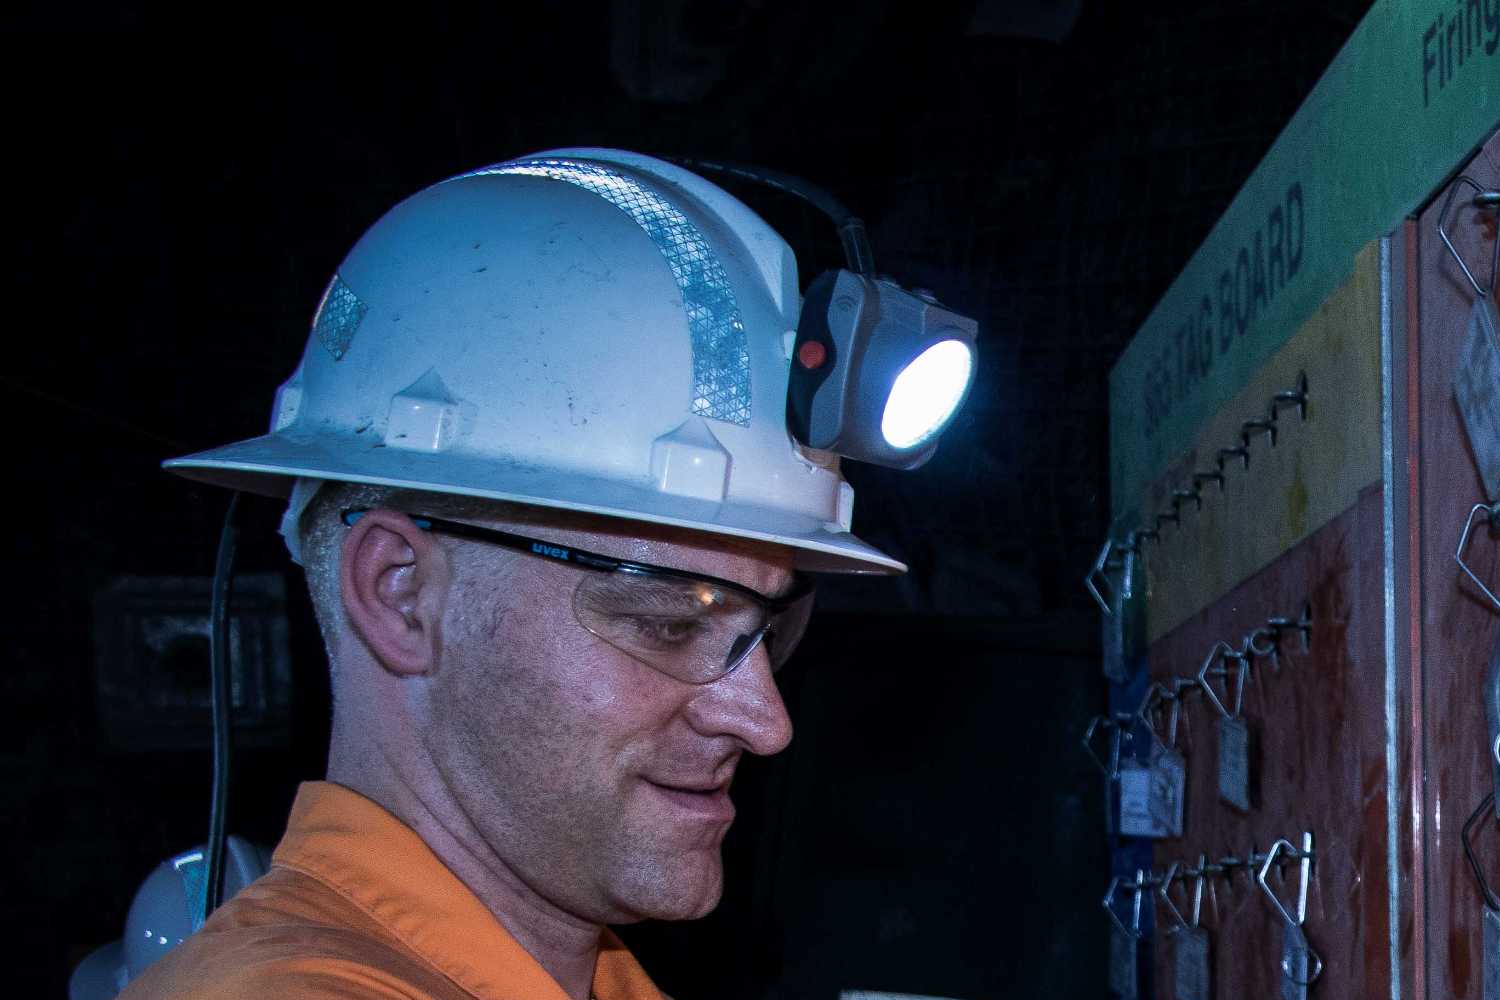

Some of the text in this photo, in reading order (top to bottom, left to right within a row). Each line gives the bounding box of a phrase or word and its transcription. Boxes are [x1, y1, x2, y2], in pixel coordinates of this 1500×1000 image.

[1423, 0, 1500, 108] Firing
[1217, 180, 1304, 355] BOARD
[532, 542, 569, 560] uvex
